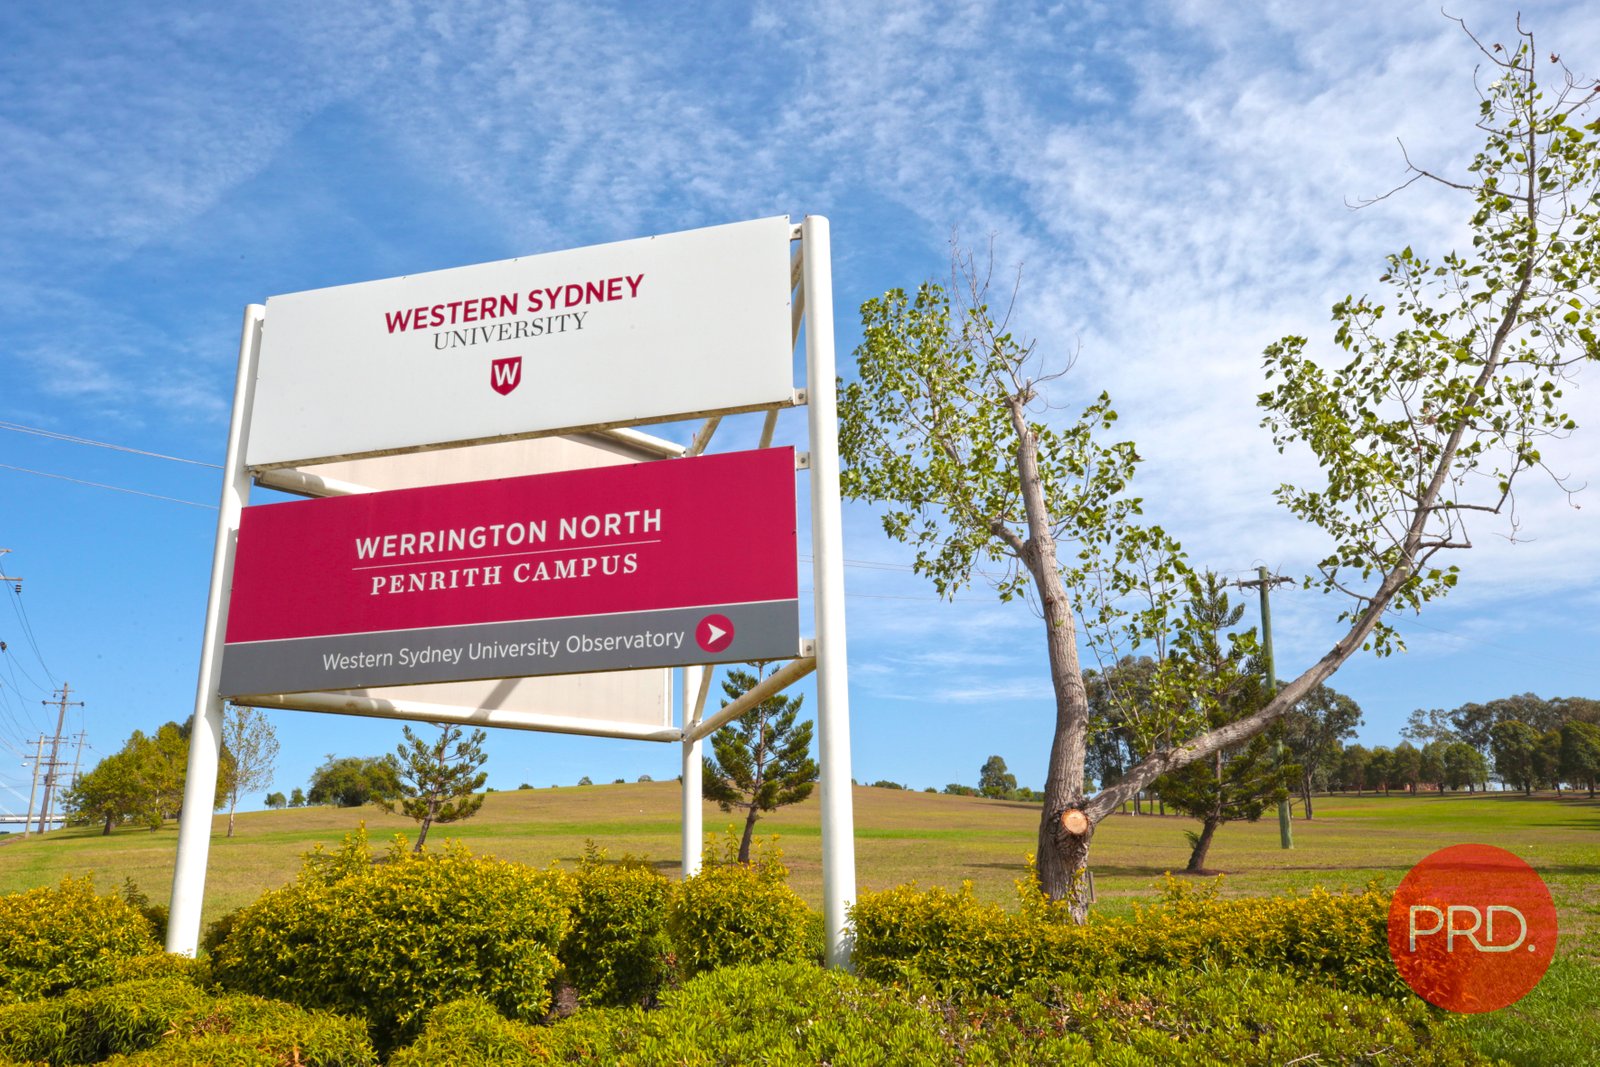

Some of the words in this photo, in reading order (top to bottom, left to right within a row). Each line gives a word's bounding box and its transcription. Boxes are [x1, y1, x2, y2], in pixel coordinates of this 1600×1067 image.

[385, 293, 519, 334] WESTERN
[527, 273, 645, 313] SYDNEY
[434, 311, 588, 350] UNIVERSITY
[355, 517, 548, 560] WERRINGTON
[559, 508, 662, 541] NORTH
[370, 565, 502, 596] PENRITH
[513, 552, 639, 583] CAMPUS
[322, 652, 393, 671] Western
[398, 645, 464, 668] Sydney
[468, 638, 561, 661] University
[566, 630, 685, 654] Observatory
